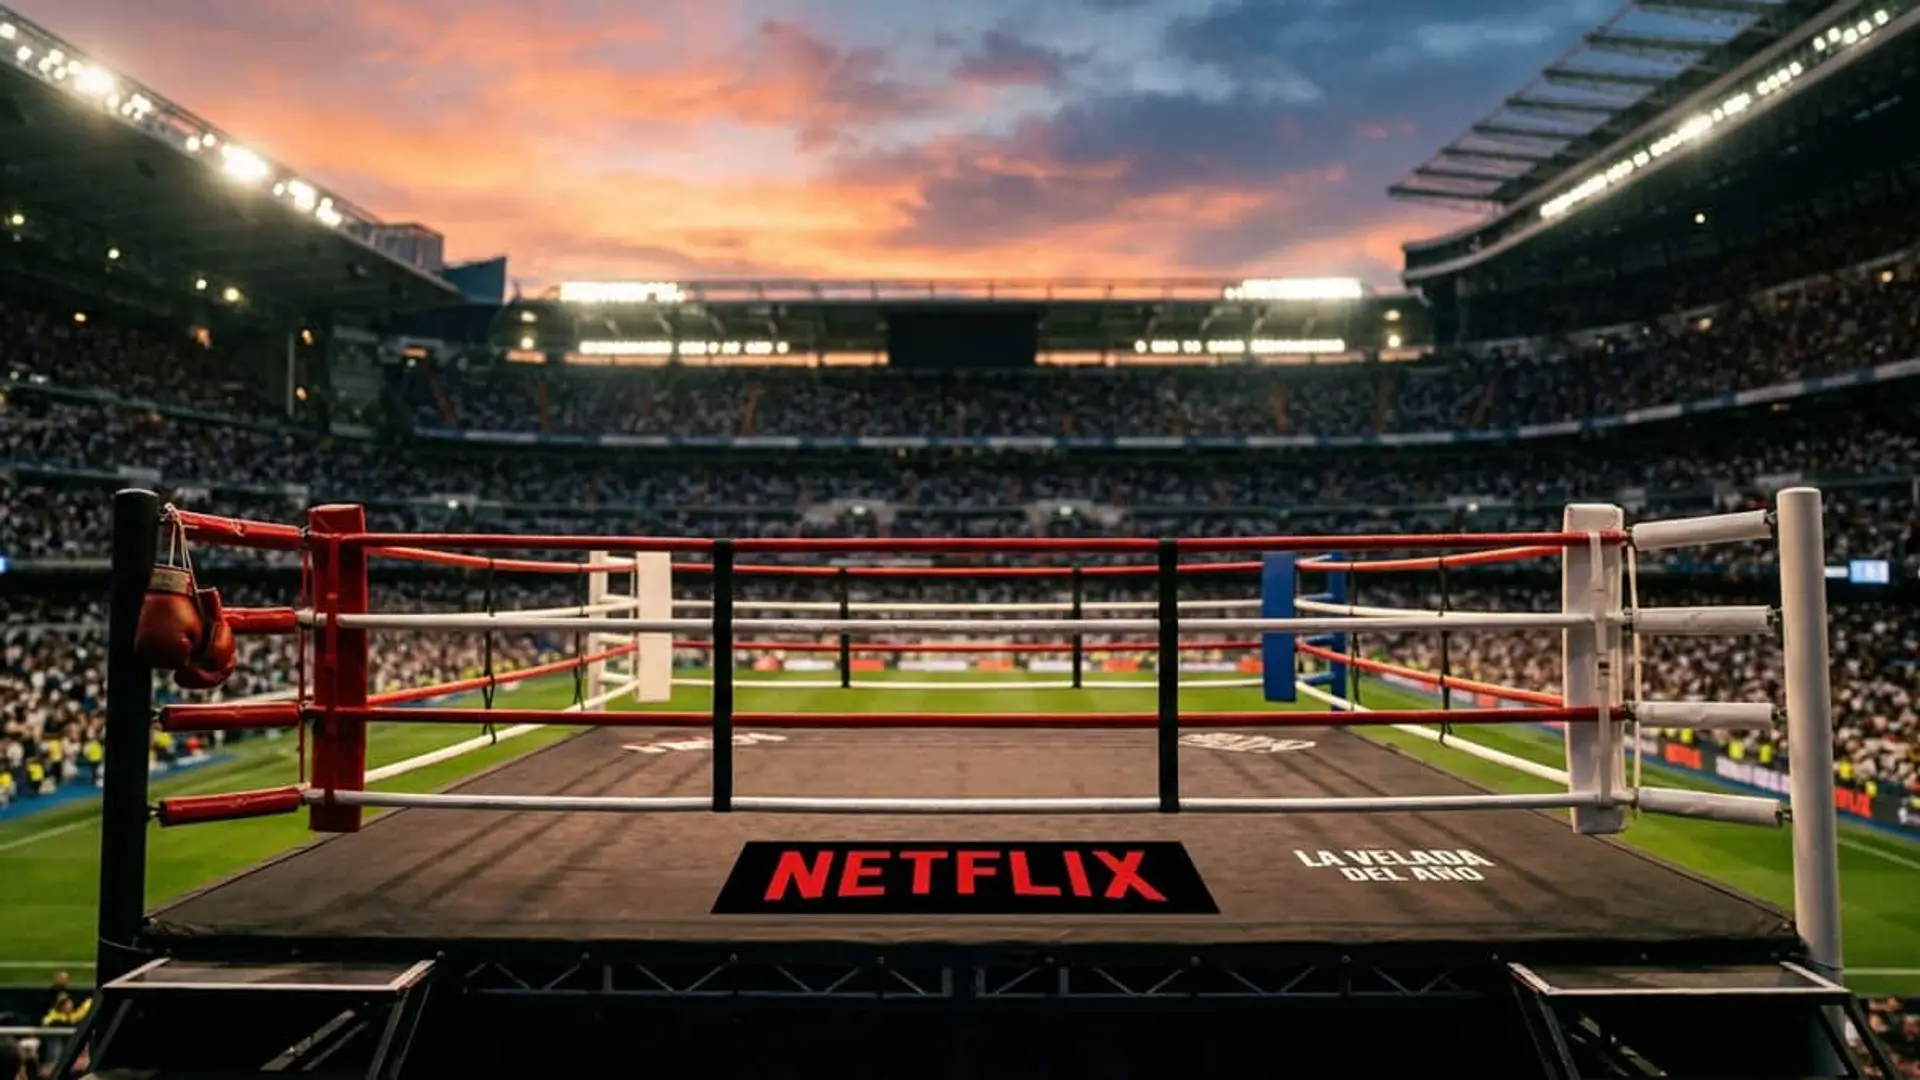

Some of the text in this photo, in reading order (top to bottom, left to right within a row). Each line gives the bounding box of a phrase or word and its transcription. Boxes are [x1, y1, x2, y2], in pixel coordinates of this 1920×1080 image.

[1293, 849, 1496, 867] LA VELADA
[764, 850, 1168, 902] NETFLIX
[1339, 867, 1409, 881] DEL
